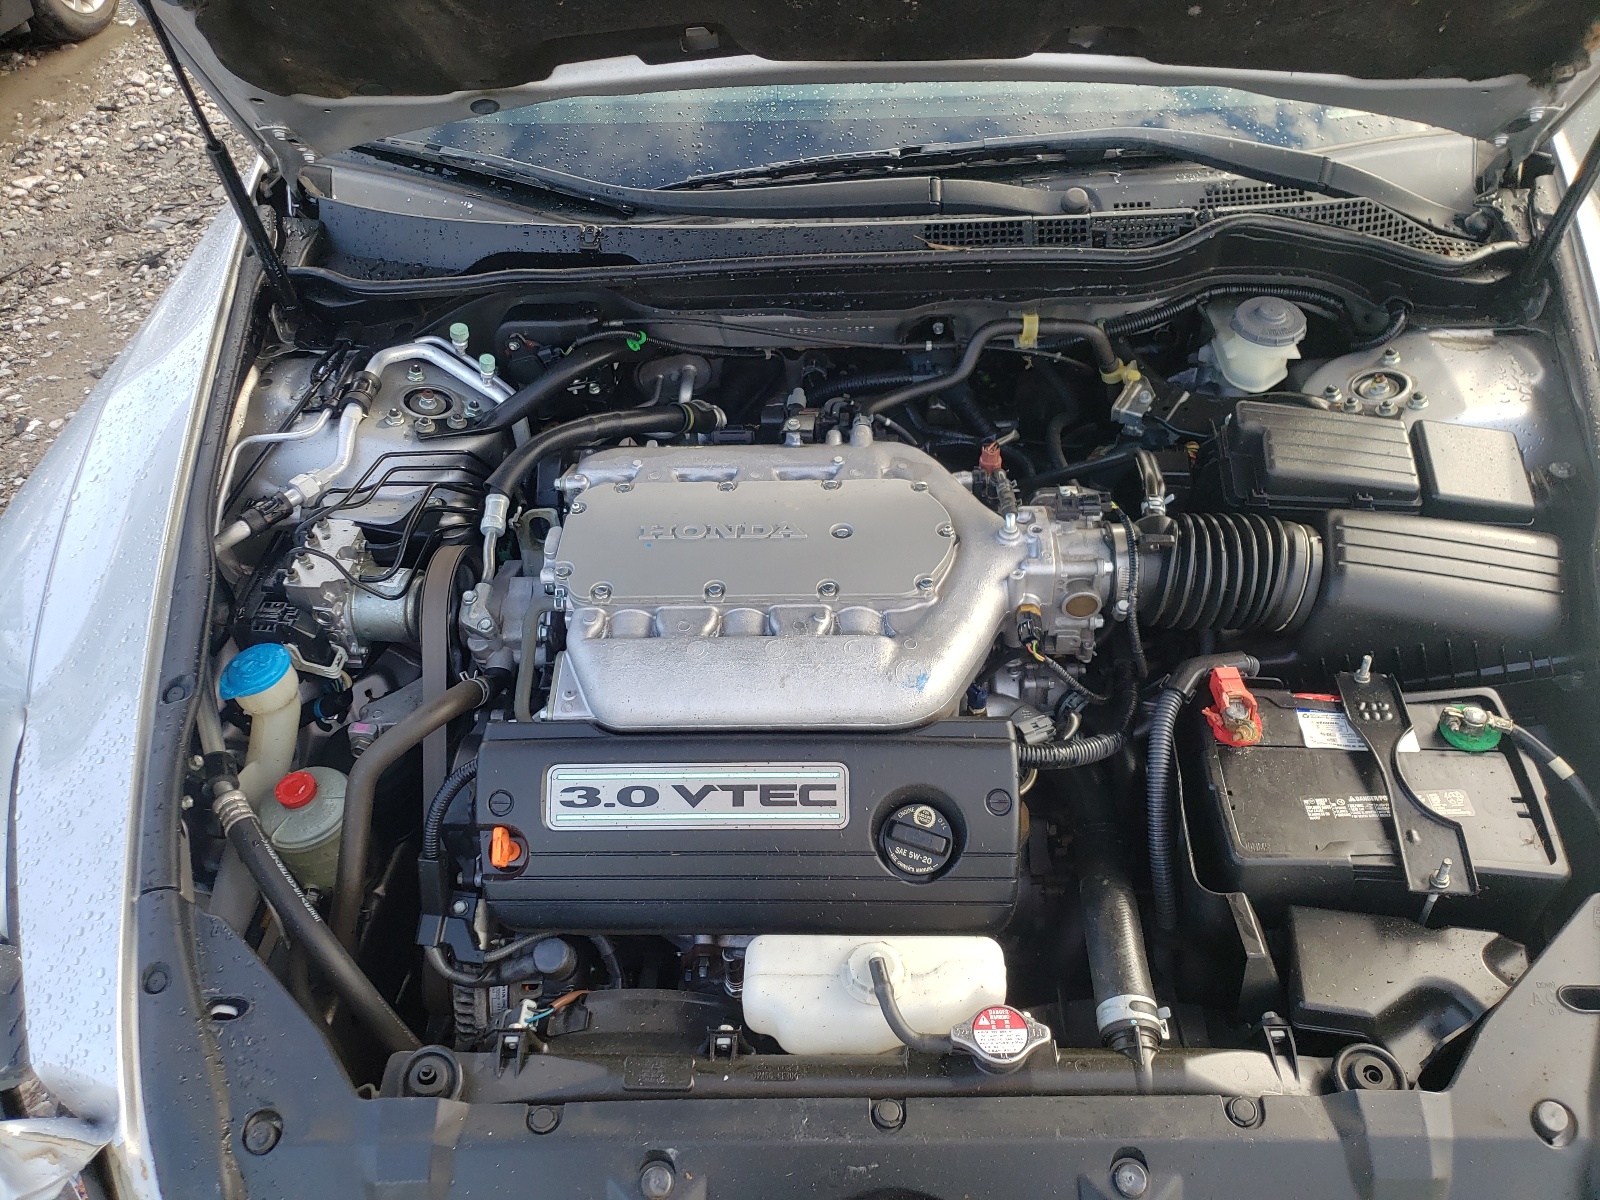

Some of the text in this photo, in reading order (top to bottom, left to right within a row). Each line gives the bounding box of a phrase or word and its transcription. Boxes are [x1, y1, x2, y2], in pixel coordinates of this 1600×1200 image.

[638, 523, 808, 540] HONDA
[559, 783, 837, 809] 3.0 VTEC
[898, 807, 915, 819] ENGINE
[938, 818, 947, 830] OIL
[894, 846, 933, 865] SAE 5W-20
